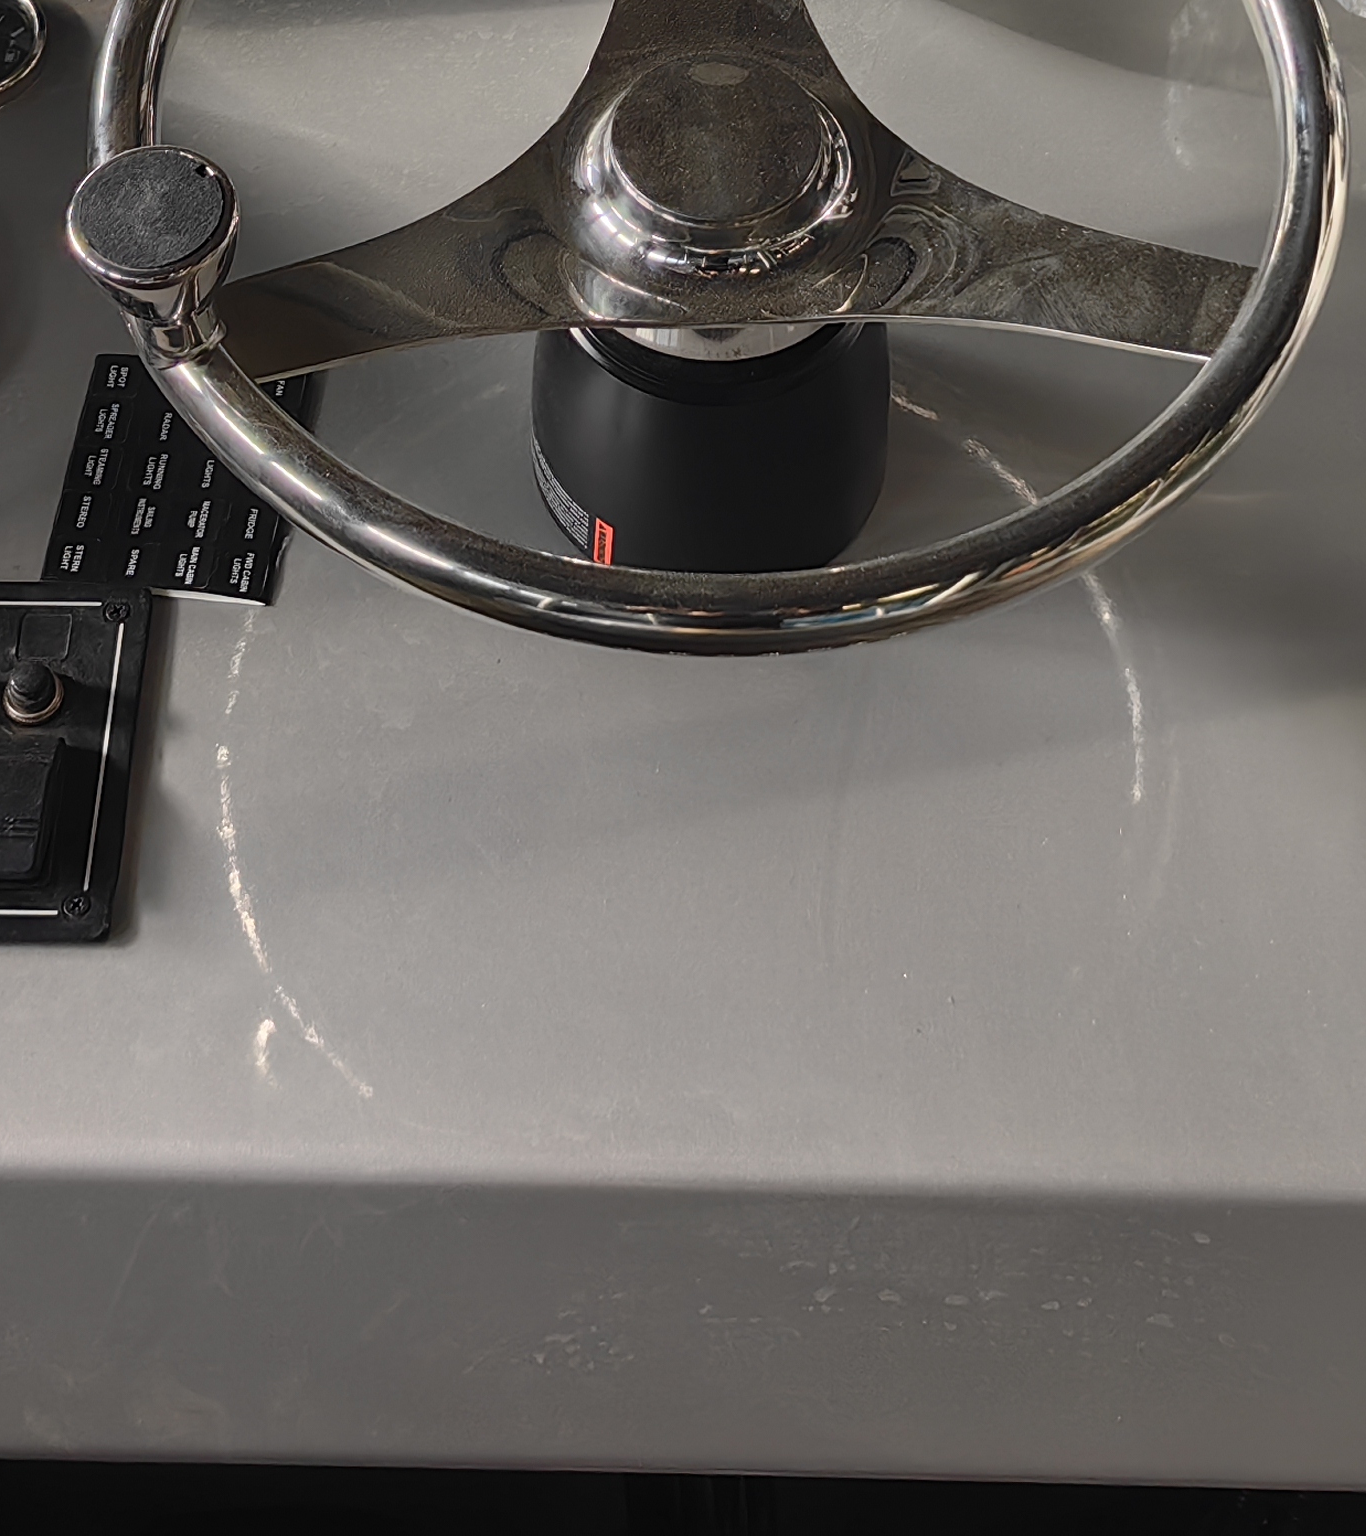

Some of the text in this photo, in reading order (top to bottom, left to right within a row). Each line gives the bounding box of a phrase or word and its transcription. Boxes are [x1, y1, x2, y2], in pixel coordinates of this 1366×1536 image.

[107, 365, 119, 388] LIGHT
[117, 366, 129, 388] SPOT
[275, 380, 286, 397] FAN
[104, 403, 120, 439] SPREADER
[159, 412, 173, 441] RADAR
[85, 455, 97, 477] LIGHT
[142, 456, 157, 487] LIGHTS
[152, 454, 168, 490] RUNNING
[201, 460, 215, 489] LIGHTS
[76, 496, 92, 528] STEREO
[244, 508, 259, 540] FRIDGE
[60, 545, 73, 570] LIGHT
[70, 545, 85, 572] STERN
[125, 549, 140, 577] SPARE
[246, 552, 256, 569] FWD
[230, 558, 243, 585] LIGHTS
